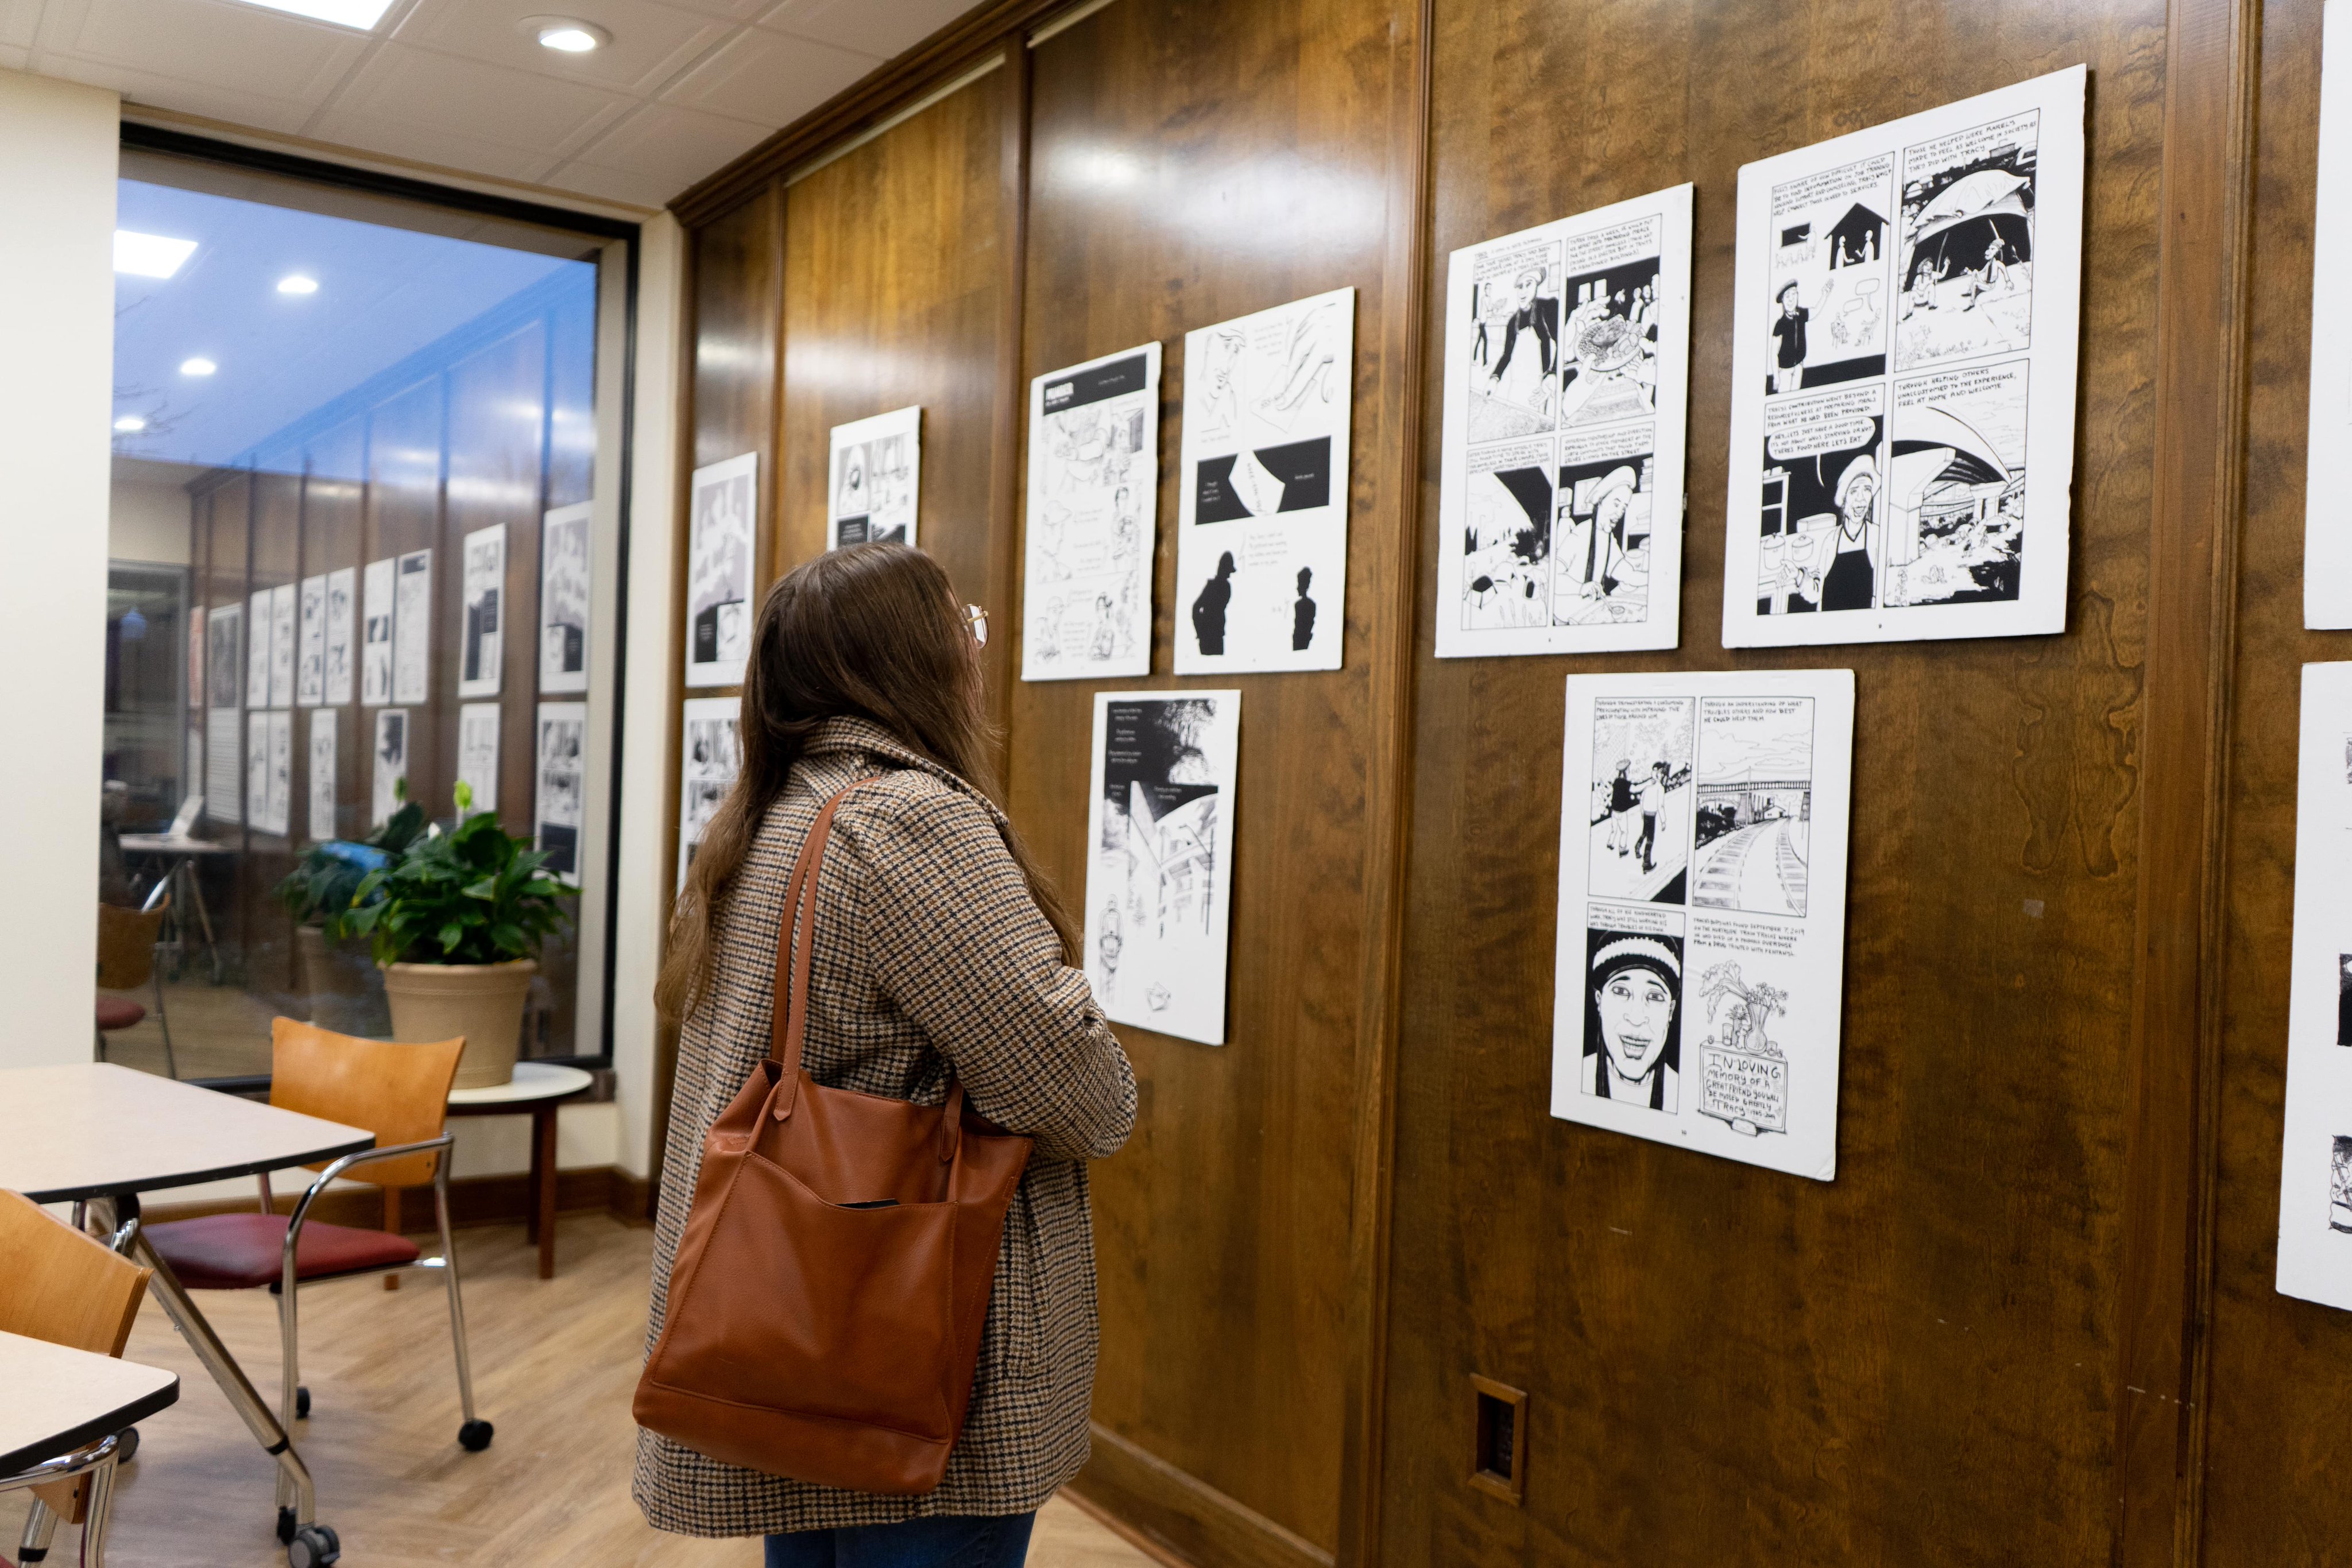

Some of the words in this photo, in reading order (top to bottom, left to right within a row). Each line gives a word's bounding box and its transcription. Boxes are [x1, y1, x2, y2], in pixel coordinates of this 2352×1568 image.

[1708, 1053, 1733, 1070] IN
[1738, 1058, 1781, 1079] LOVING
[1708, 1069, 1746, 1085] MEMORY
[1750, 1077, 1761, 1086] OF
[1765, 1079, 1770, 1090] A
[1712, 1099, 1746, 1117] TRACY
